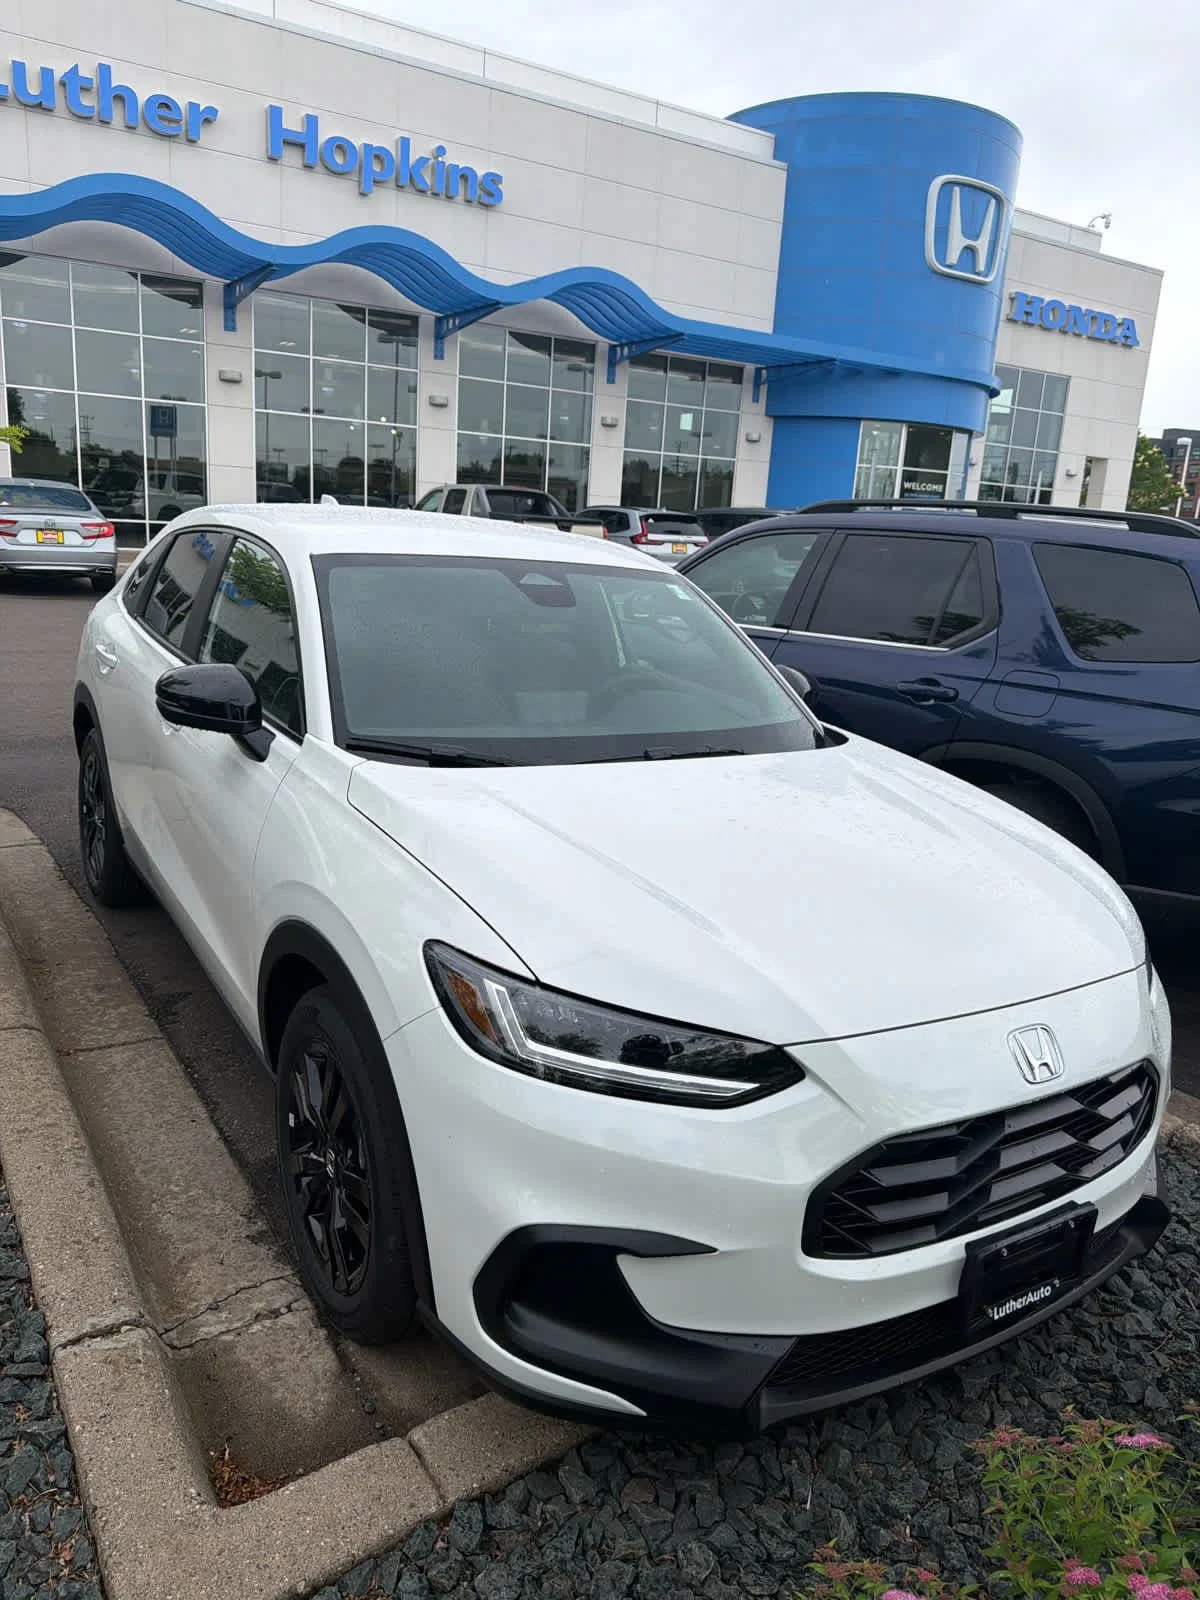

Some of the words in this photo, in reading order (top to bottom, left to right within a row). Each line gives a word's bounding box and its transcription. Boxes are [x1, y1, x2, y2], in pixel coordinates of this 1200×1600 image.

[266, 104, 503, 206] Hopkins
[1007, 291, 1139, 346] HONDA
[903, 481, 944, 492] WELCOME
[994, 1285, 1051, 1320] LutherAuto
